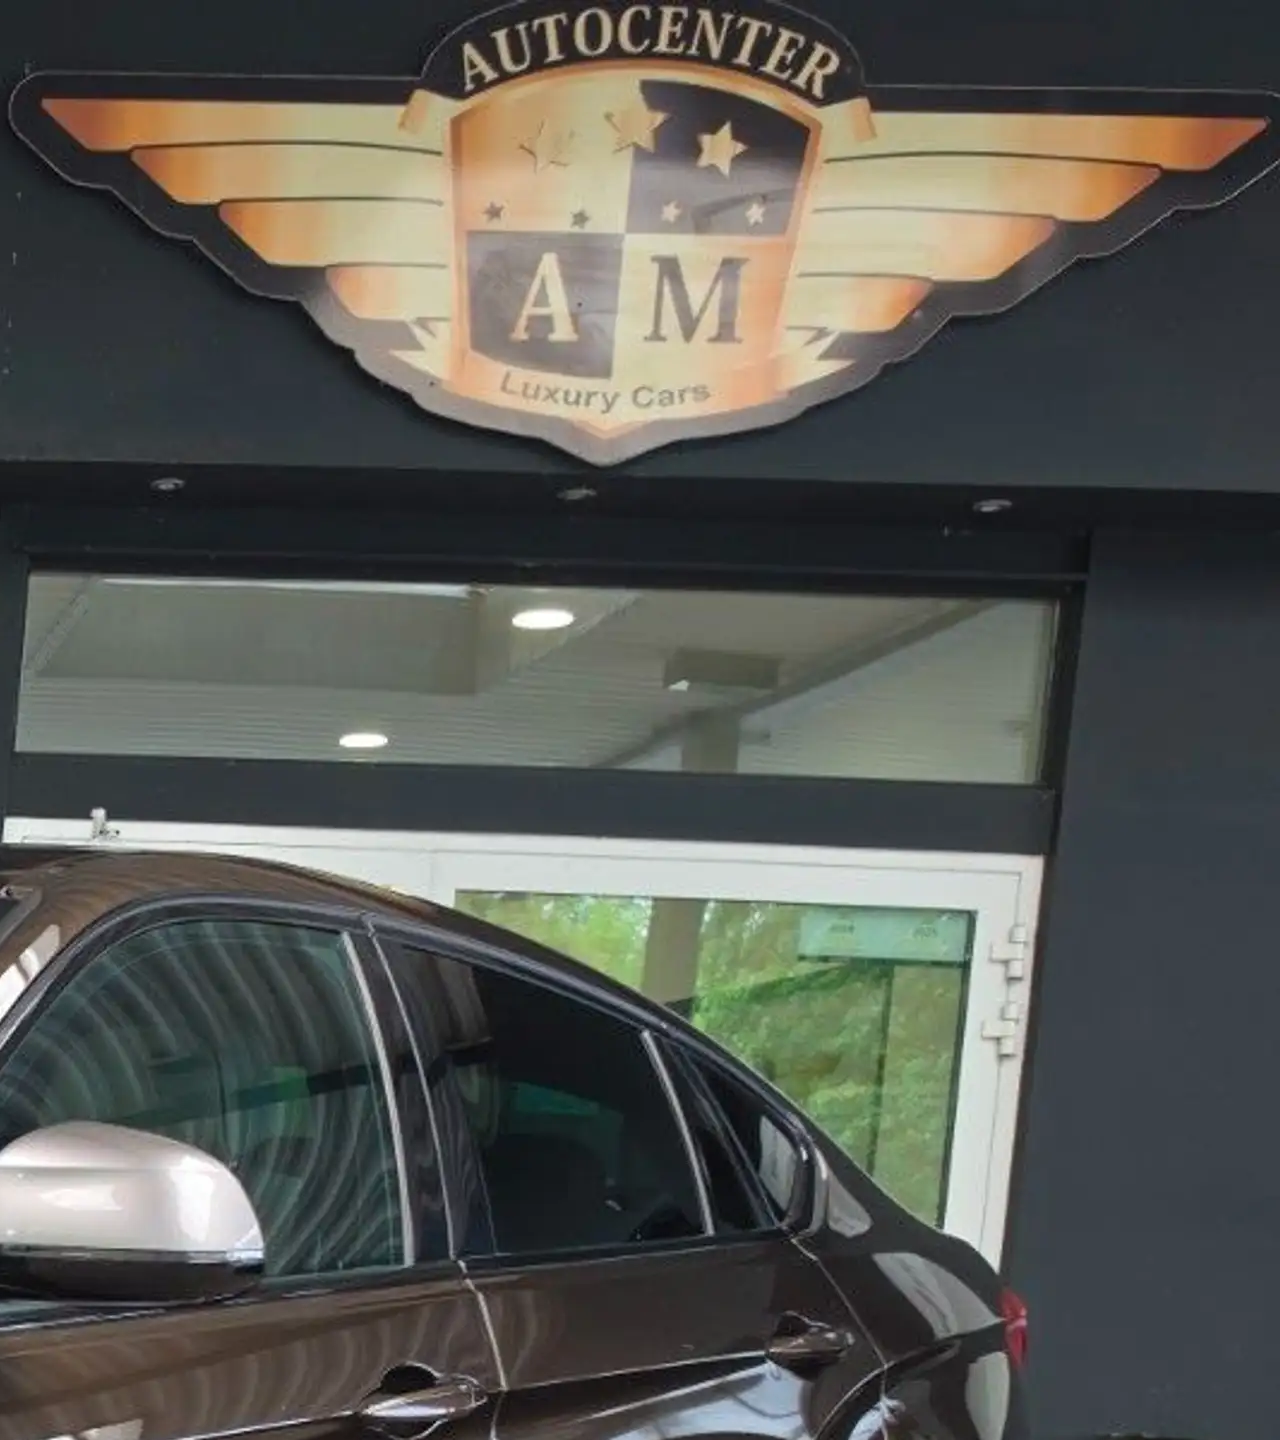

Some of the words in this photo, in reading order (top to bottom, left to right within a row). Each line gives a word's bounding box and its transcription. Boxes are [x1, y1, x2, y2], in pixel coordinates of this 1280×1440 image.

[460, 6, 840, 99] AUTOCENTER
[509, 252, 579, 342] A
[643, 253, 750, 344] M
[500, 370, 620, 414] Luxury
[631, 382, 711, 409] Cars
